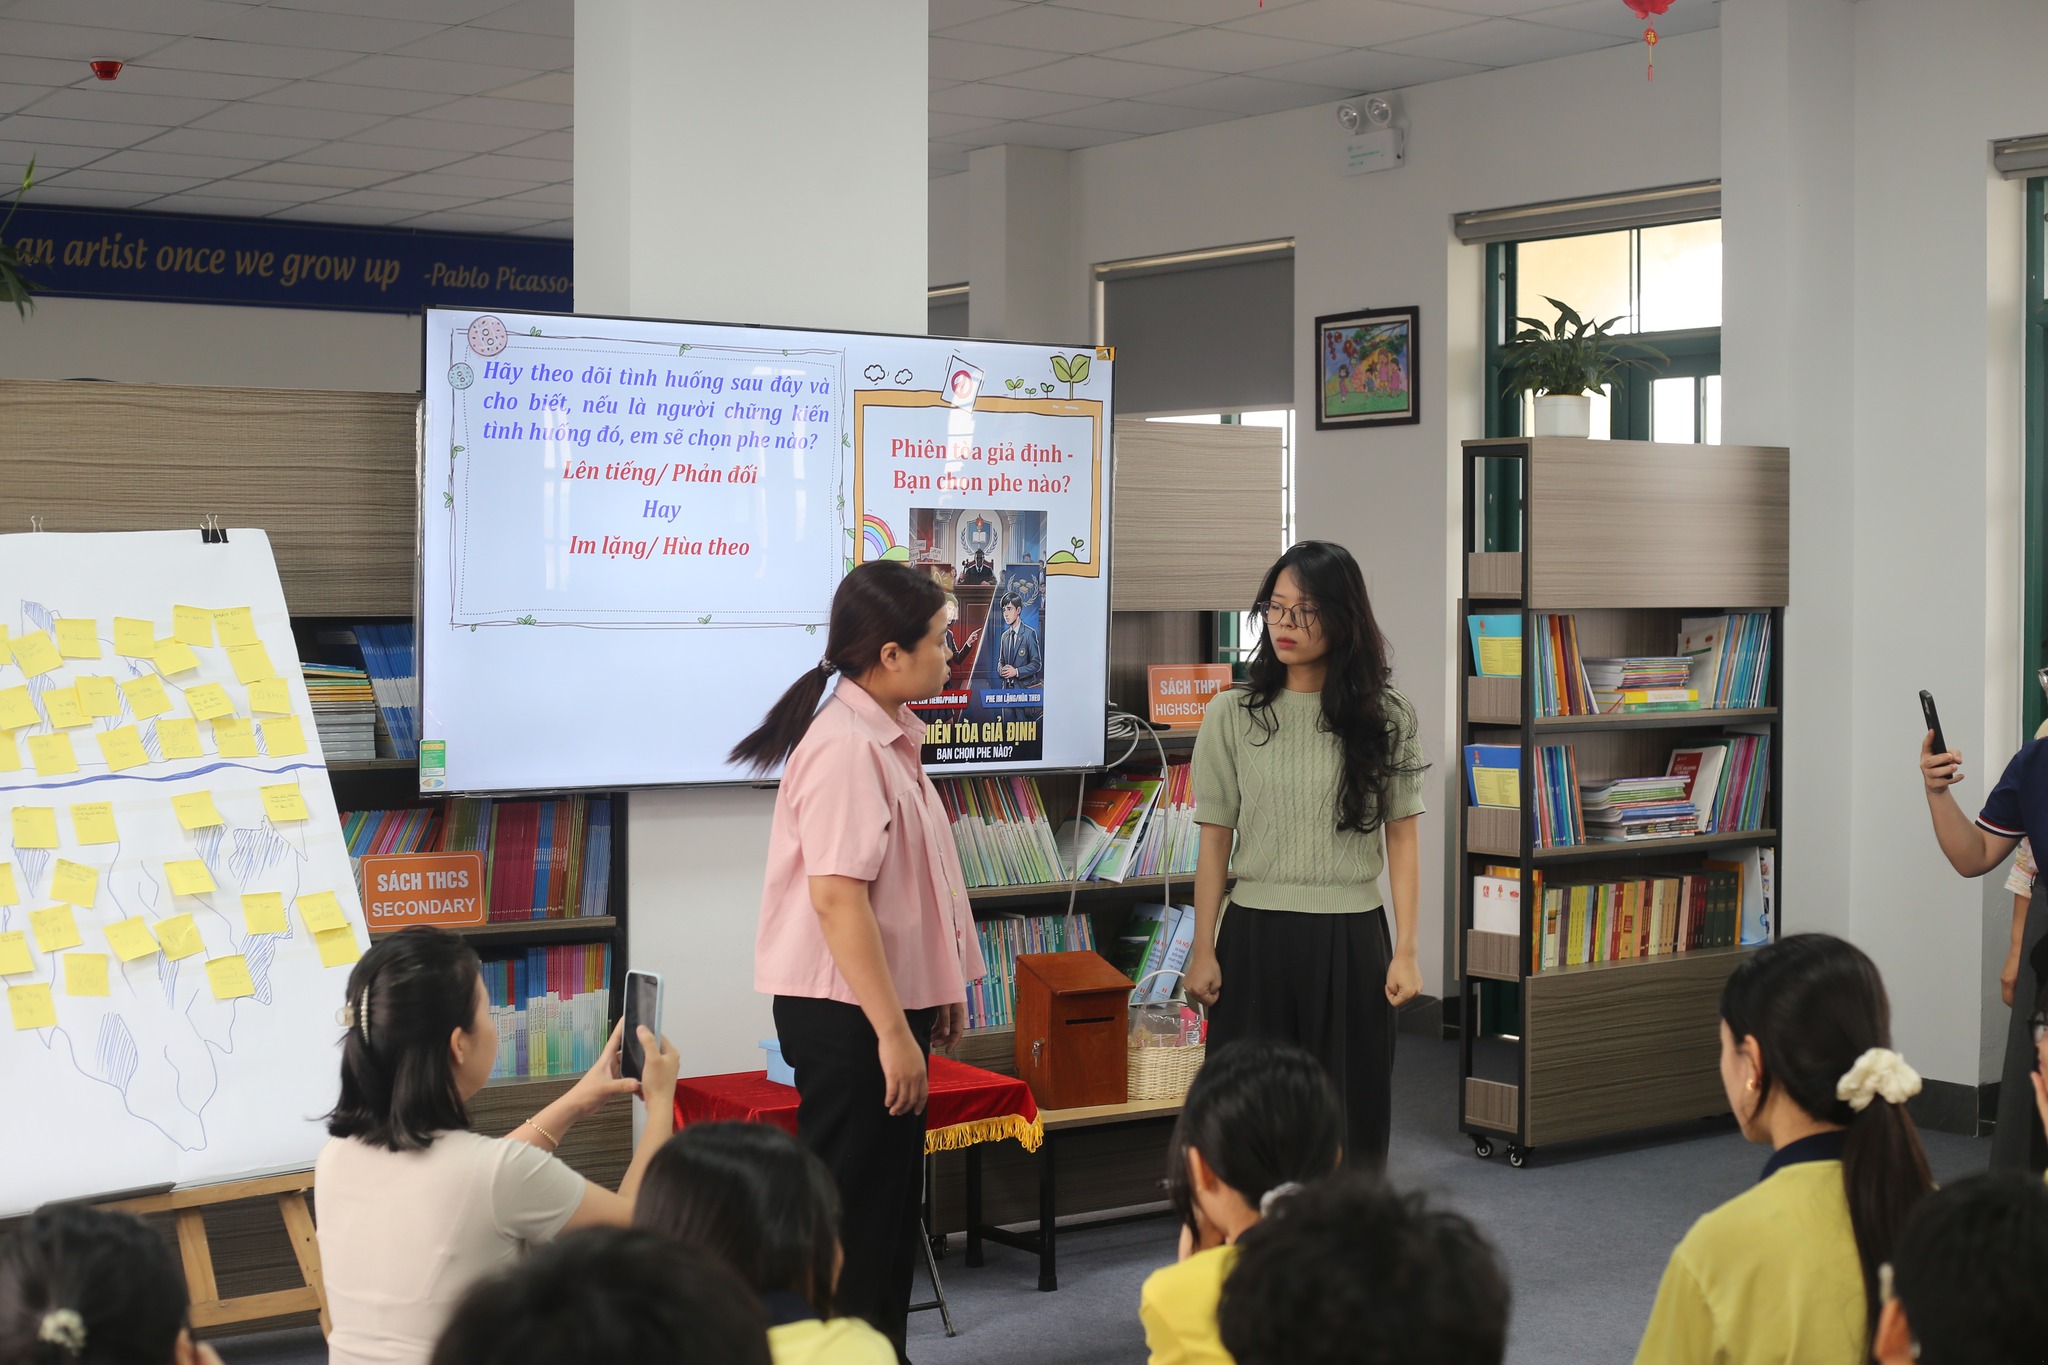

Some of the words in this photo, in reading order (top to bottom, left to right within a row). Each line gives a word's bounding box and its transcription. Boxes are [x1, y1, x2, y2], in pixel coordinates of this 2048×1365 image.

[15, 236, 55, 265] an
[63, 232, 148, 269] artist
[156, 245, 226, 274] once
[235, 250, 274, 277] we
[280, 253, 357, 287] grow
[363, 257, 400, 292] up
[424, 262, 489, 289] -Pablo
[483, 360, 524, 386] Hãy
[530, 363, 574, 383] theo
[581, 365, 613, 385] dõi
[619, 367, 657, 387] tình
[665, 369, 725, 395] huống
[730, 377, 763, 392] sau
[769, 375, 803, 398] đây
[809, 377, 831, 395] và
[482, 390, 519, 411] cho
[528, 392, 572, 415] biết,
[582, 395, 619, 415] nếu
[628, 396, 647, 416] là
[656, 399, 715, 422] người
[724, 401, 783, 426] chững
[791, 404, 830, 423] kiến
[483, 420, 524, 440] tình
[529, 421, 592, 447] huống
[596, 424, 625, 446] đó,
[629, 431, 659, 445] em
[663, 429, 684, 445] sẽ
[687, 428, 731, 452] chọn
[735, 430, 771, 452] phe
[774, 431, 819, 450] nào?
[890, 438, 948, 459] Phiên
[953, 440, 983, 461] tòa
[987, 442, 1016, 466] giả
[1020, 443, 1063, 467] định
[563, 460, 600, 480] Lên
[605, 461, 669, 487] tiếng/
[672, 463, 723, 483] Phản
[727, 465, 758, 484] đối
[893, 469, 931, 494] Bạn
[936, 471, 983, 496] chọn
[987, 471, 1023, 497] phe
[1027, 474, 1072, 494] nào?
[643, 499, 681, 523] Hay
[569, 535, 597, 555] Im
[601, 535, 659, 560] lặng/
[662, 536, 703, 556] Hùa
[707, 537, 750, 556] theo
[1160, 677, 1191, 695] SÁCH
[1194, 679, 1222, 694] THPT
[1155, 702, 1208, 716] HIGHSCH
[923, 718, 951, 744] HIÊN
[955, 718, 979, 743] TÒA
[982, 716, 1003, 742] GIẢ
[1006, 721, 1037, 745] ĐỊNH
[936, 748, 953, 762] BẠN
[954, 748, 975, 762] CHỌN
[976, 746, 990, 759] PHE
[993, 744, 1013, 758] NÀO?
[377, 870, 422, 892] SÁCH
[426, 870, 469, 889] THCS
[371, 897, 476, 918] SECONDARY
